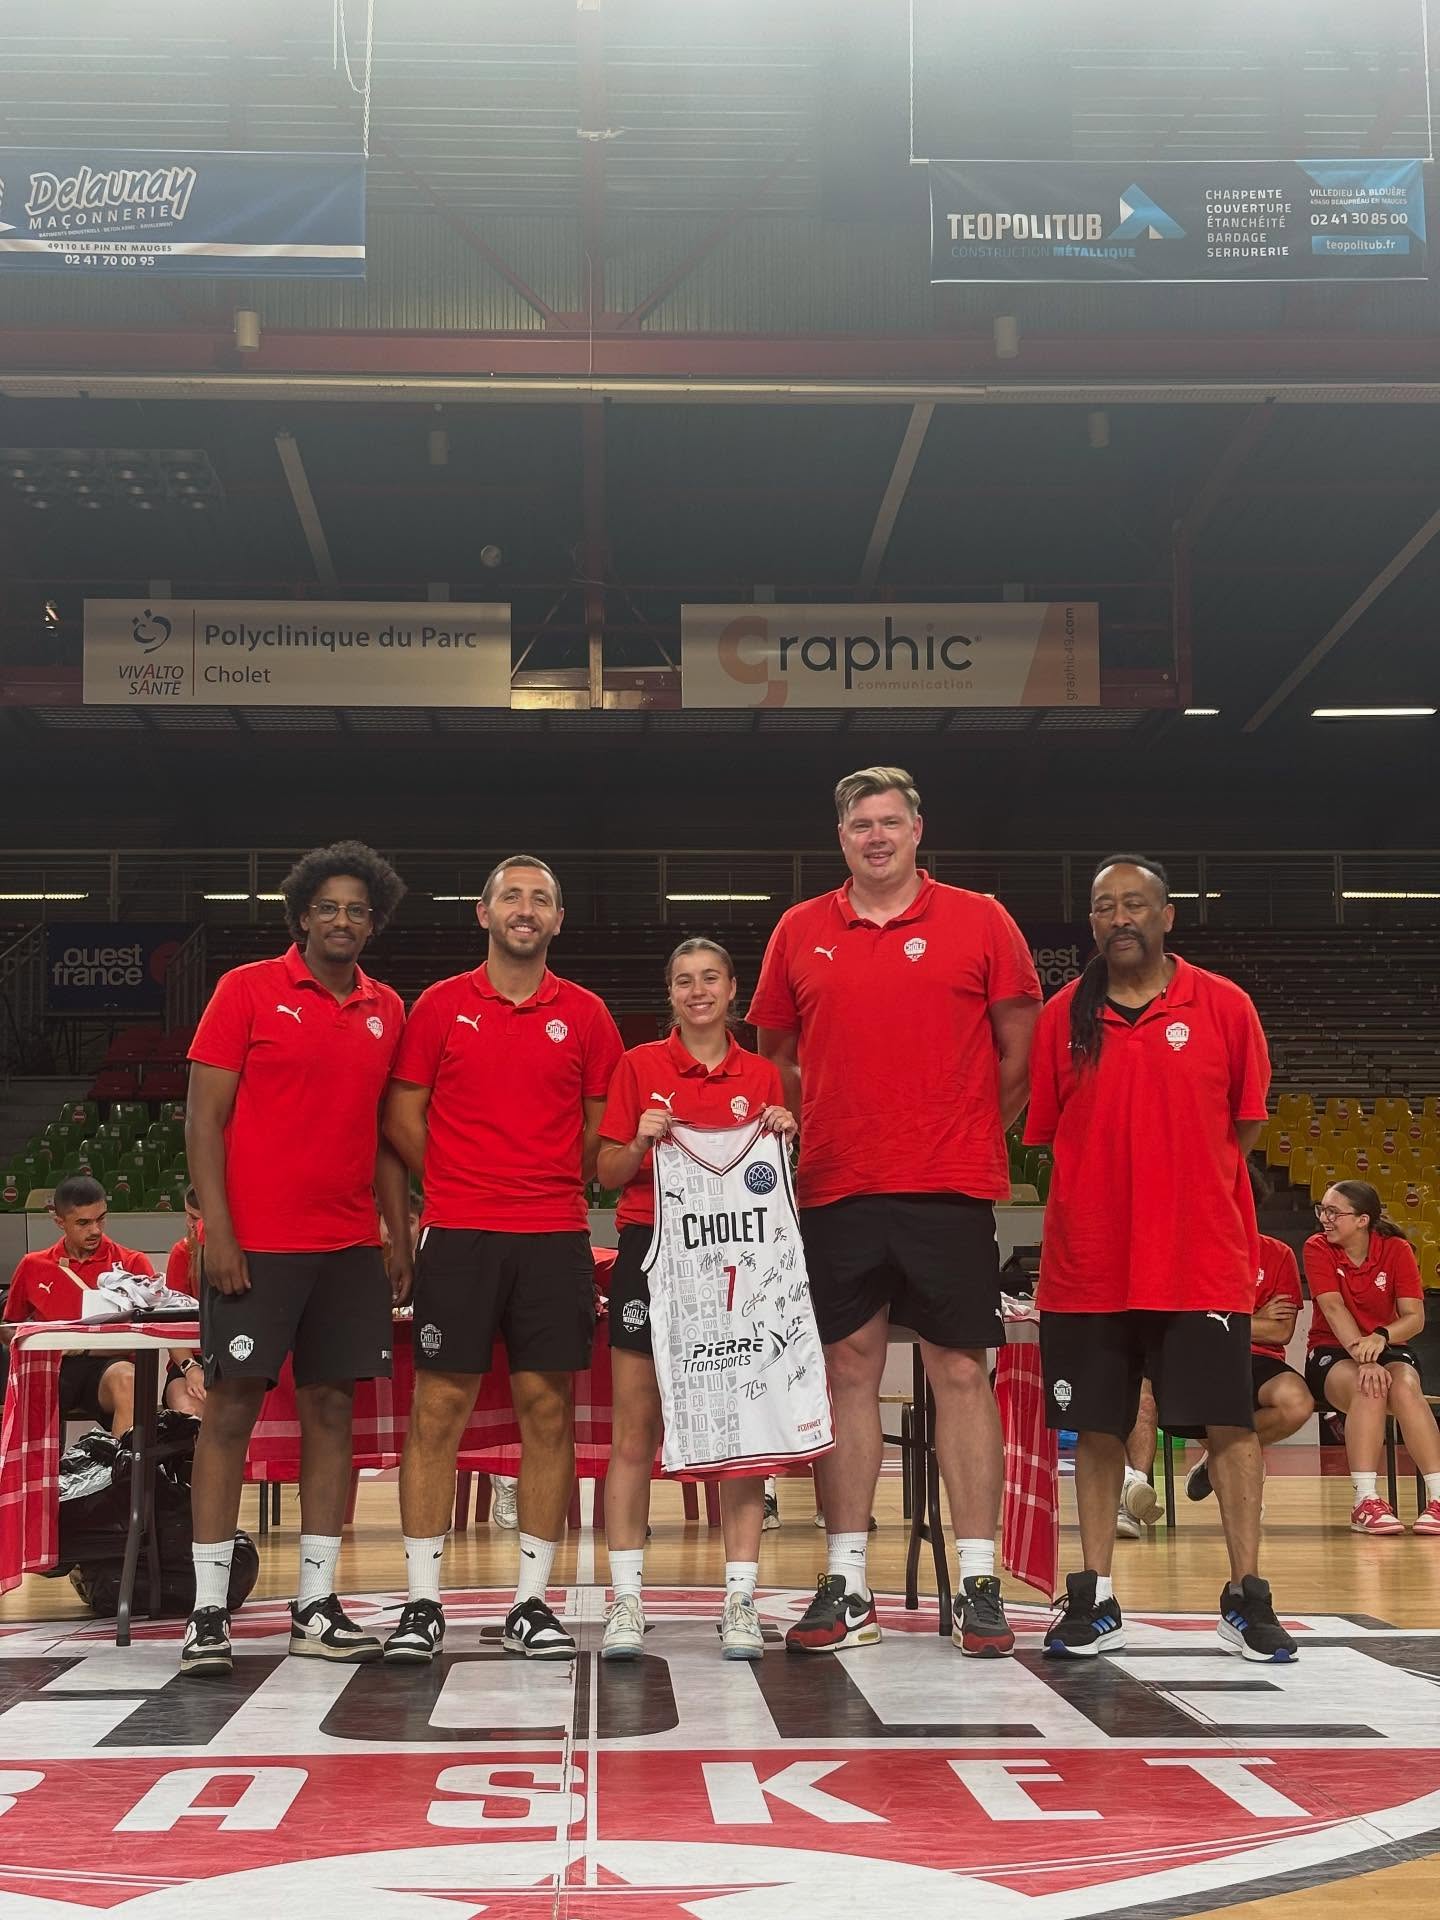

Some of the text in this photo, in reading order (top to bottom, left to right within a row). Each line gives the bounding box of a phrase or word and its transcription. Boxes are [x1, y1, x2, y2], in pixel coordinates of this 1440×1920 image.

[25, 165, 197, 220] Delaunay
[1205, 189, 1283, 200] CHARPENTE
[1309, 188, 1353, 197] VILLEDIEU
[1355, 188, 1366, 197] LA
[1205, 203, 1293, 214] COUVERTURE
[29, 205, 169, 231] MAÇONNERIE
[946, 212, 1103, 241] TEOPOLITUB
[1207, 215, 1286, 228] ÉTANCHÉITÉ
[1310, 212, 1408, 225] 02 41 30 85 00
[1207, 232, 1267, 243] BARDAGE
[1326, 239, 1396, 253] teopolitub.fr
[80, 243, 91, 251] LE
[114, 244, 127, 252] EN
[131, 244, 173, 252] MAUGES
[951, 243, 1137, 260] CONSTRUCTION MÉTALLIQUE
[1207, 246, 1289, 258] SERRURERIE
[64, 254, 155, 266] 02 41 70 00 95
[204, 623, 478, 652] Polyclinique du Parc
[1064, 607, 1078, 701] graphic49.com
[118, 663, 184, 681] VIVALTO
[203, 665, 271, 685] Cholet
[856, 678, 974, 691] communication
[63, 943, 144, 967] ouest
[52, 962, 144, 986] france
[681, 1206, 768, 1250] CHOLET
[723, 1265, 737, 1312] 7
[622, 1305, 649, 1321] CHOLET
[229, 1340, 255, 1353] CHOLET
[682, 1354, 752, 1374] Transports
[0, 1756, 1313, 1832] ASKET
